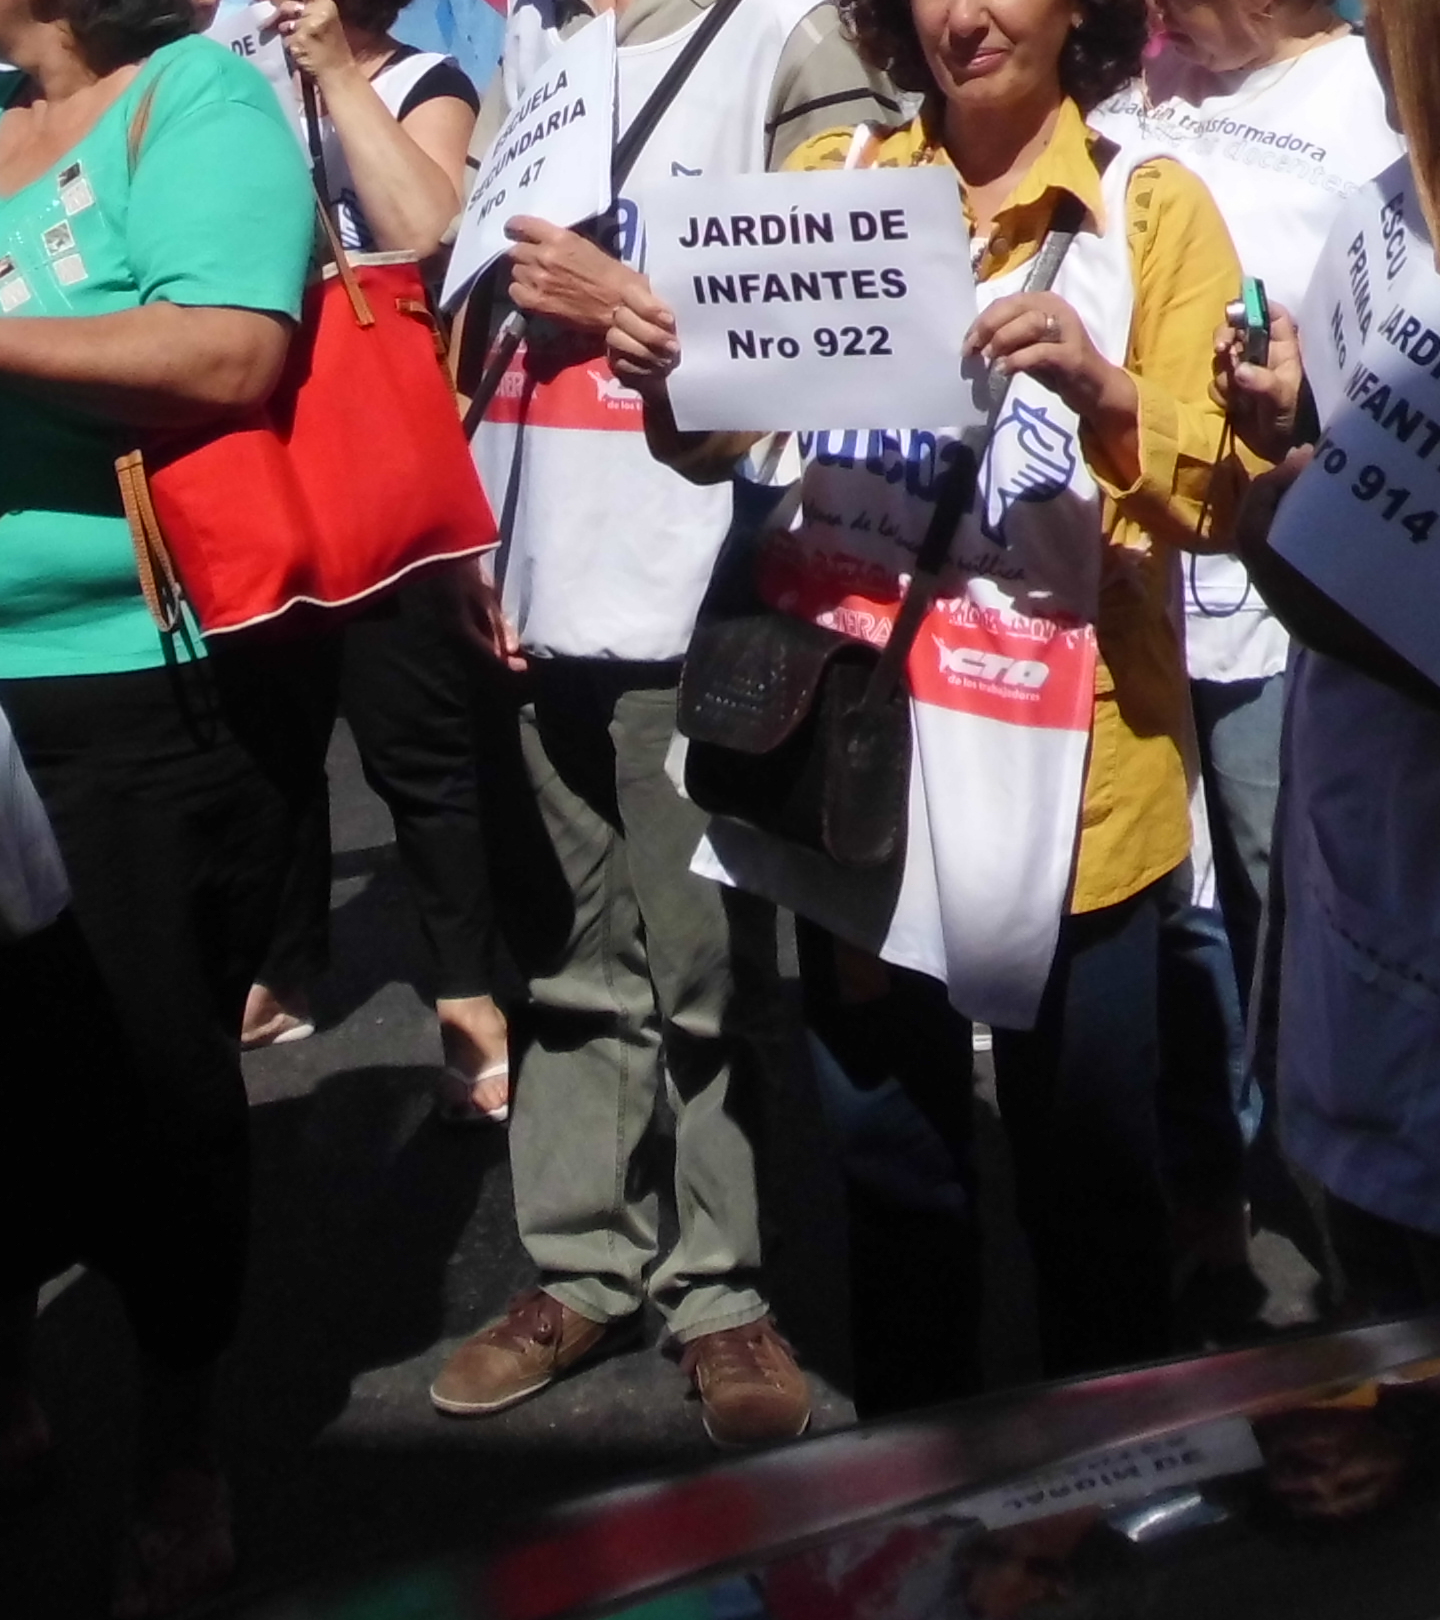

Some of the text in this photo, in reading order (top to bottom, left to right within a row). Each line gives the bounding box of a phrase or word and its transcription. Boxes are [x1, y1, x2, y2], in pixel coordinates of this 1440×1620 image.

[493, 70, 569, 159] ESCUELA
[468, 98, 587, 211] SECUNDARIA
[477, 157, 546, 226] Nro 47
[679, 204, 833, 249] JARDÍN
[849, 209, 909, 241] DE
[692, 269, 908, 305] INFANTES
[729, 326, 893, 360] Nro 922
[1313, 426, 1440, 544] ro 914
